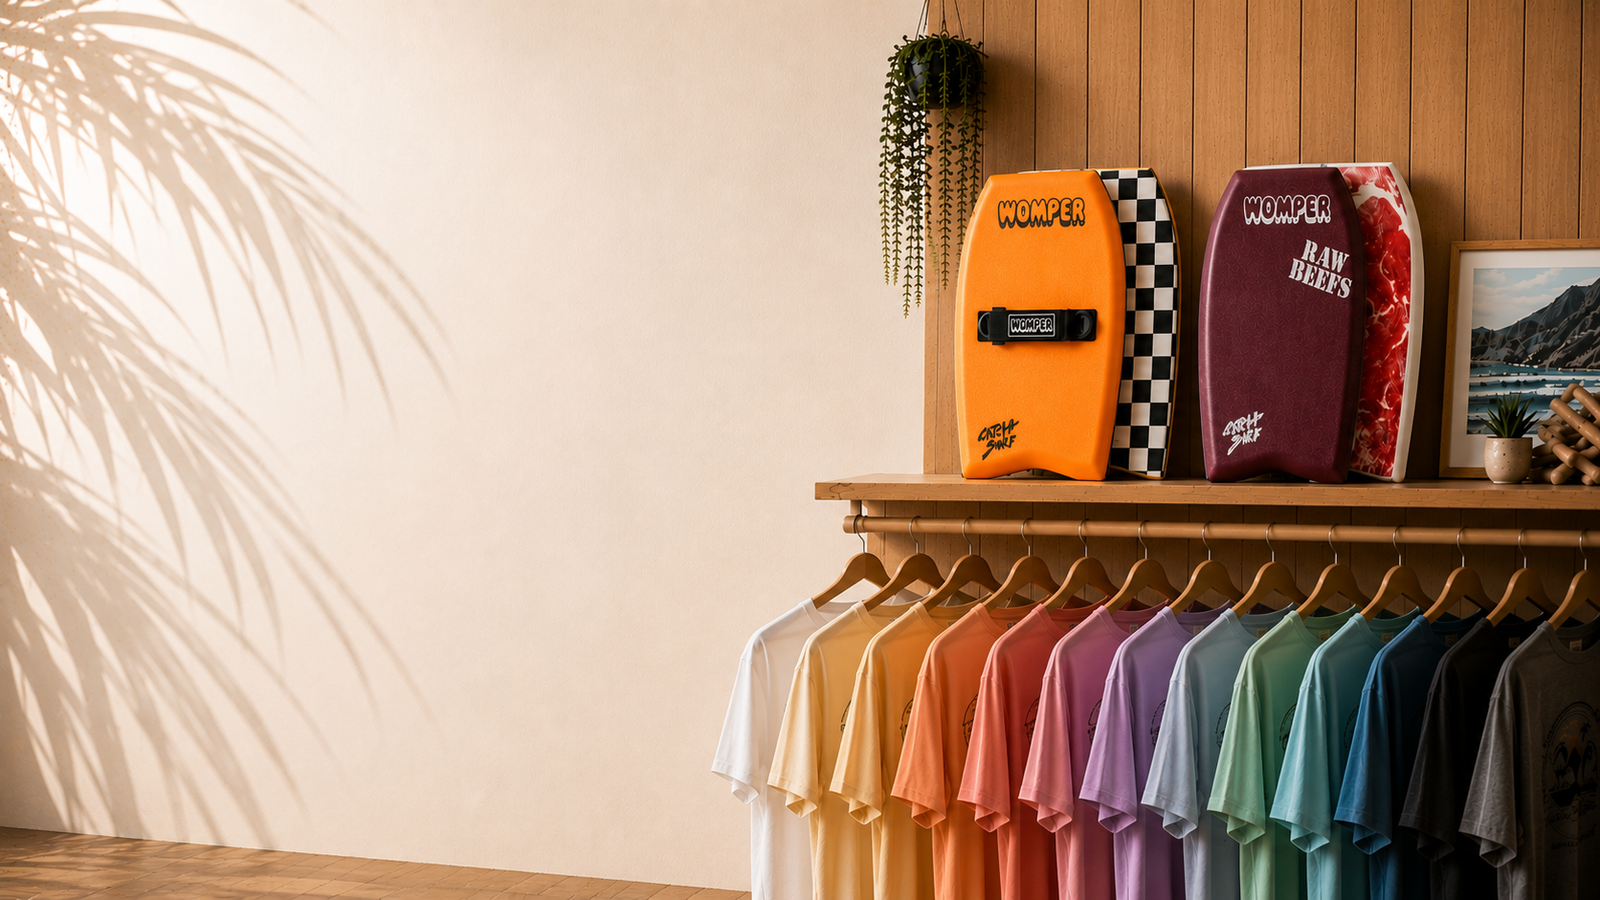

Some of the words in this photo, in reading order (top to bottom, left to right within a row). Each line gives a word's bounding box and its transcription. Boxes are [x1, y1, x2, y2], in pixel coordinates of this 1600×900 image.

[997, 197, 1086, 230] WOMPER
[1243, 194, 1332, 225] WOMPER
[1301, 239, 1350, 273] RAW
[1288, 258, 1353, 299] BEEFS
[1010, 317, 1053, 333] WOMPER
